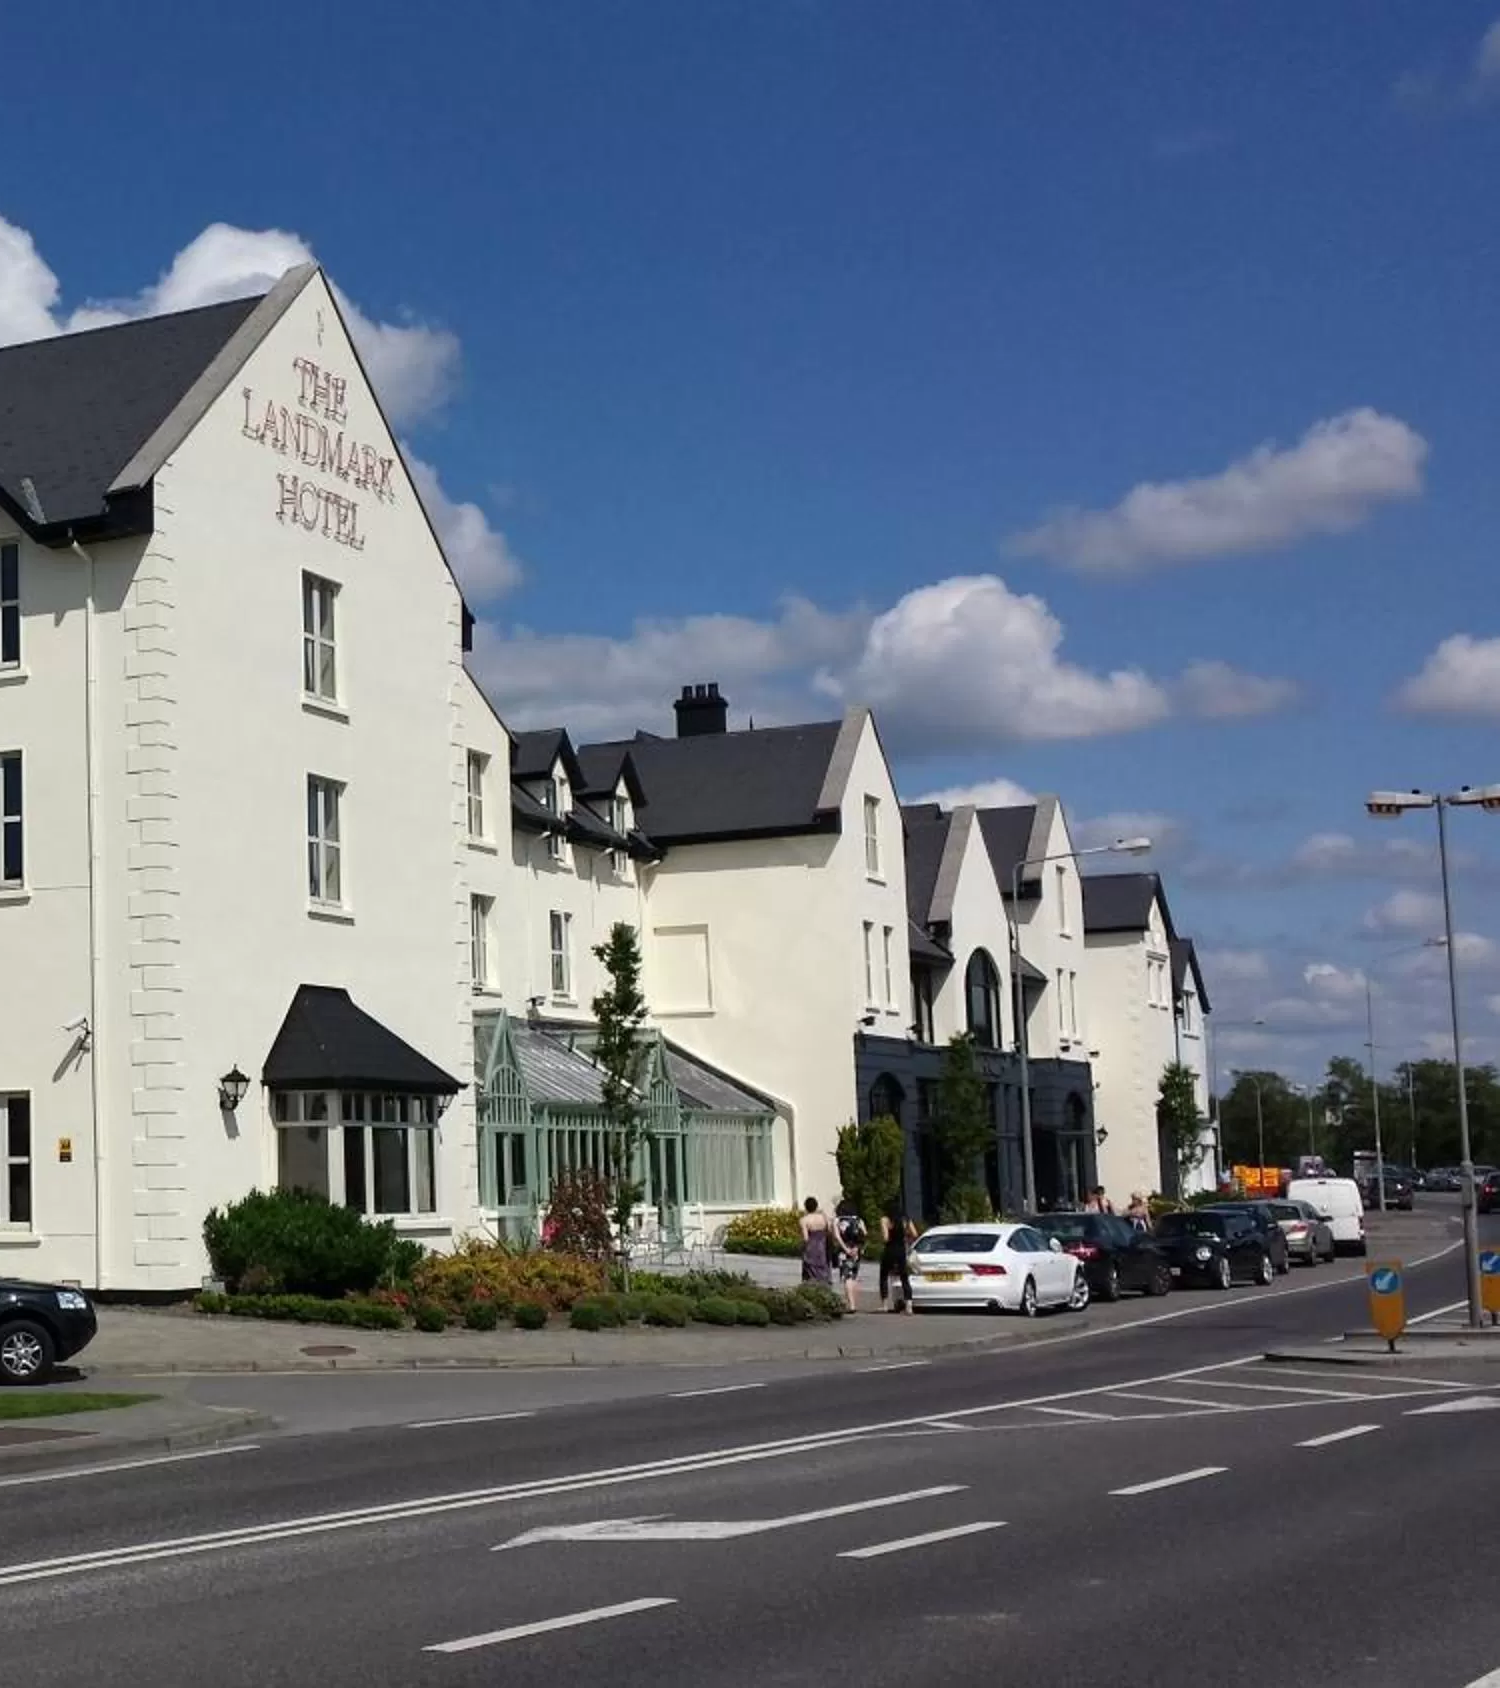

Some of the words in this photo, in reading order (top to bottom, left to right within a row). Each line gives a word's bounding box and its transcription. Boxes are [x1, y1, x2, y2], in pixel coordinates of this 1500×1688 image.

[292, 356, 348, 424] THE
[241, 386, 396, 504] LANDMARK
[275, 472, 366, 551] HOTEL
